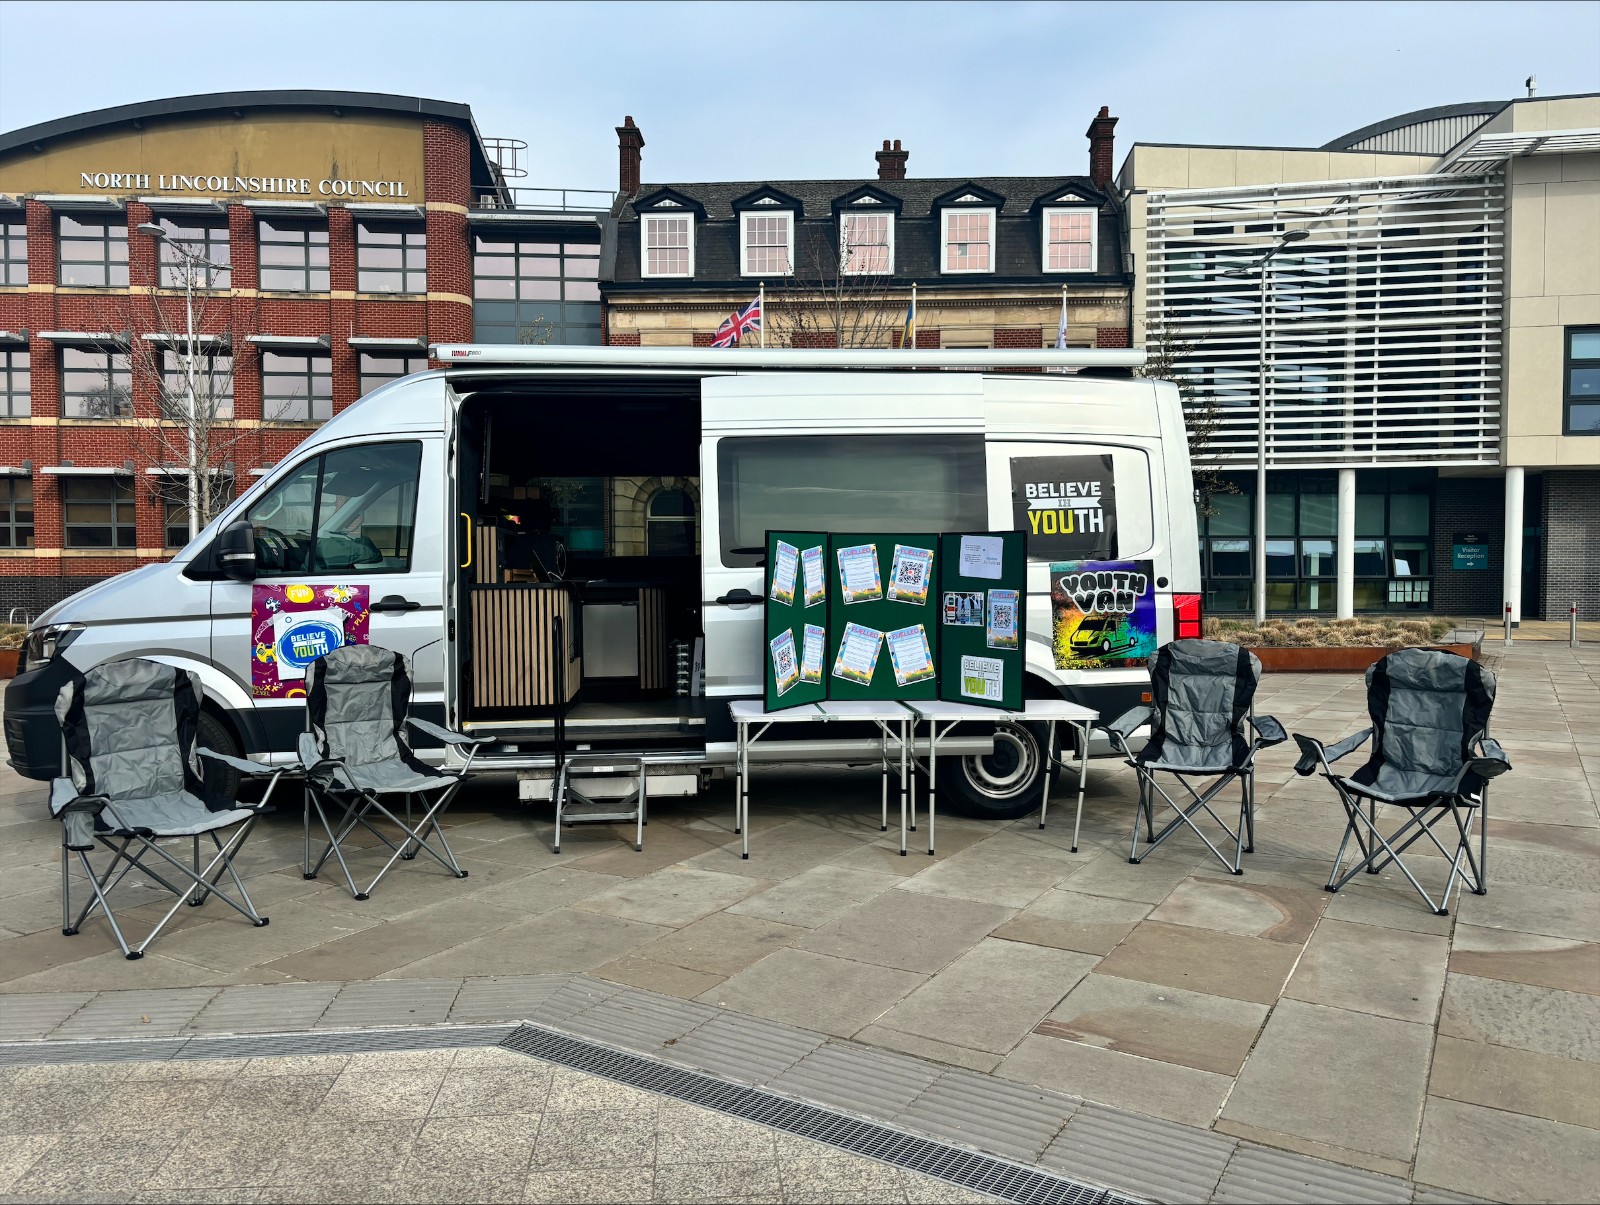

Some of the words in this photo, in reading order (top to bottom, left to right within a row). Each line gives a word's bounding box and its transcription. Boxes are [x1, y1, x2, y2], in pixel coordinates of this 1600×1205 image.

[80, 172, 150, 189] NORTH
[159, 174, 311, 194] LINCOLNSHIRE
[318, 179, 409, 197] COUNCIL
[1025, 481, 1101, 498] BELIEVE
[1058, 499, 1071, 507] IN
[1027, 509, 1104, 535] YOUTH
[843, 547, 871, 557] FUELLED
[900, 549, 929, 558] FUELLED
[1060, 571, 1147, 596] YOUTH
[290, 588, 310, 598] FUN
[1074, 590, 1136, 614] VAN
[354, 609, 370, 627] PLAY
[290, 631, 327, 642] BELIEVE
[851, 626, 879, 639] FUELLED
[891, 627, 919, 640] FUELLED
[293, 643, 329, 658] YOUTH
[964, 659, 1000, 673] BELIEVE
[964, 676, 1000, 697] YOUTH
